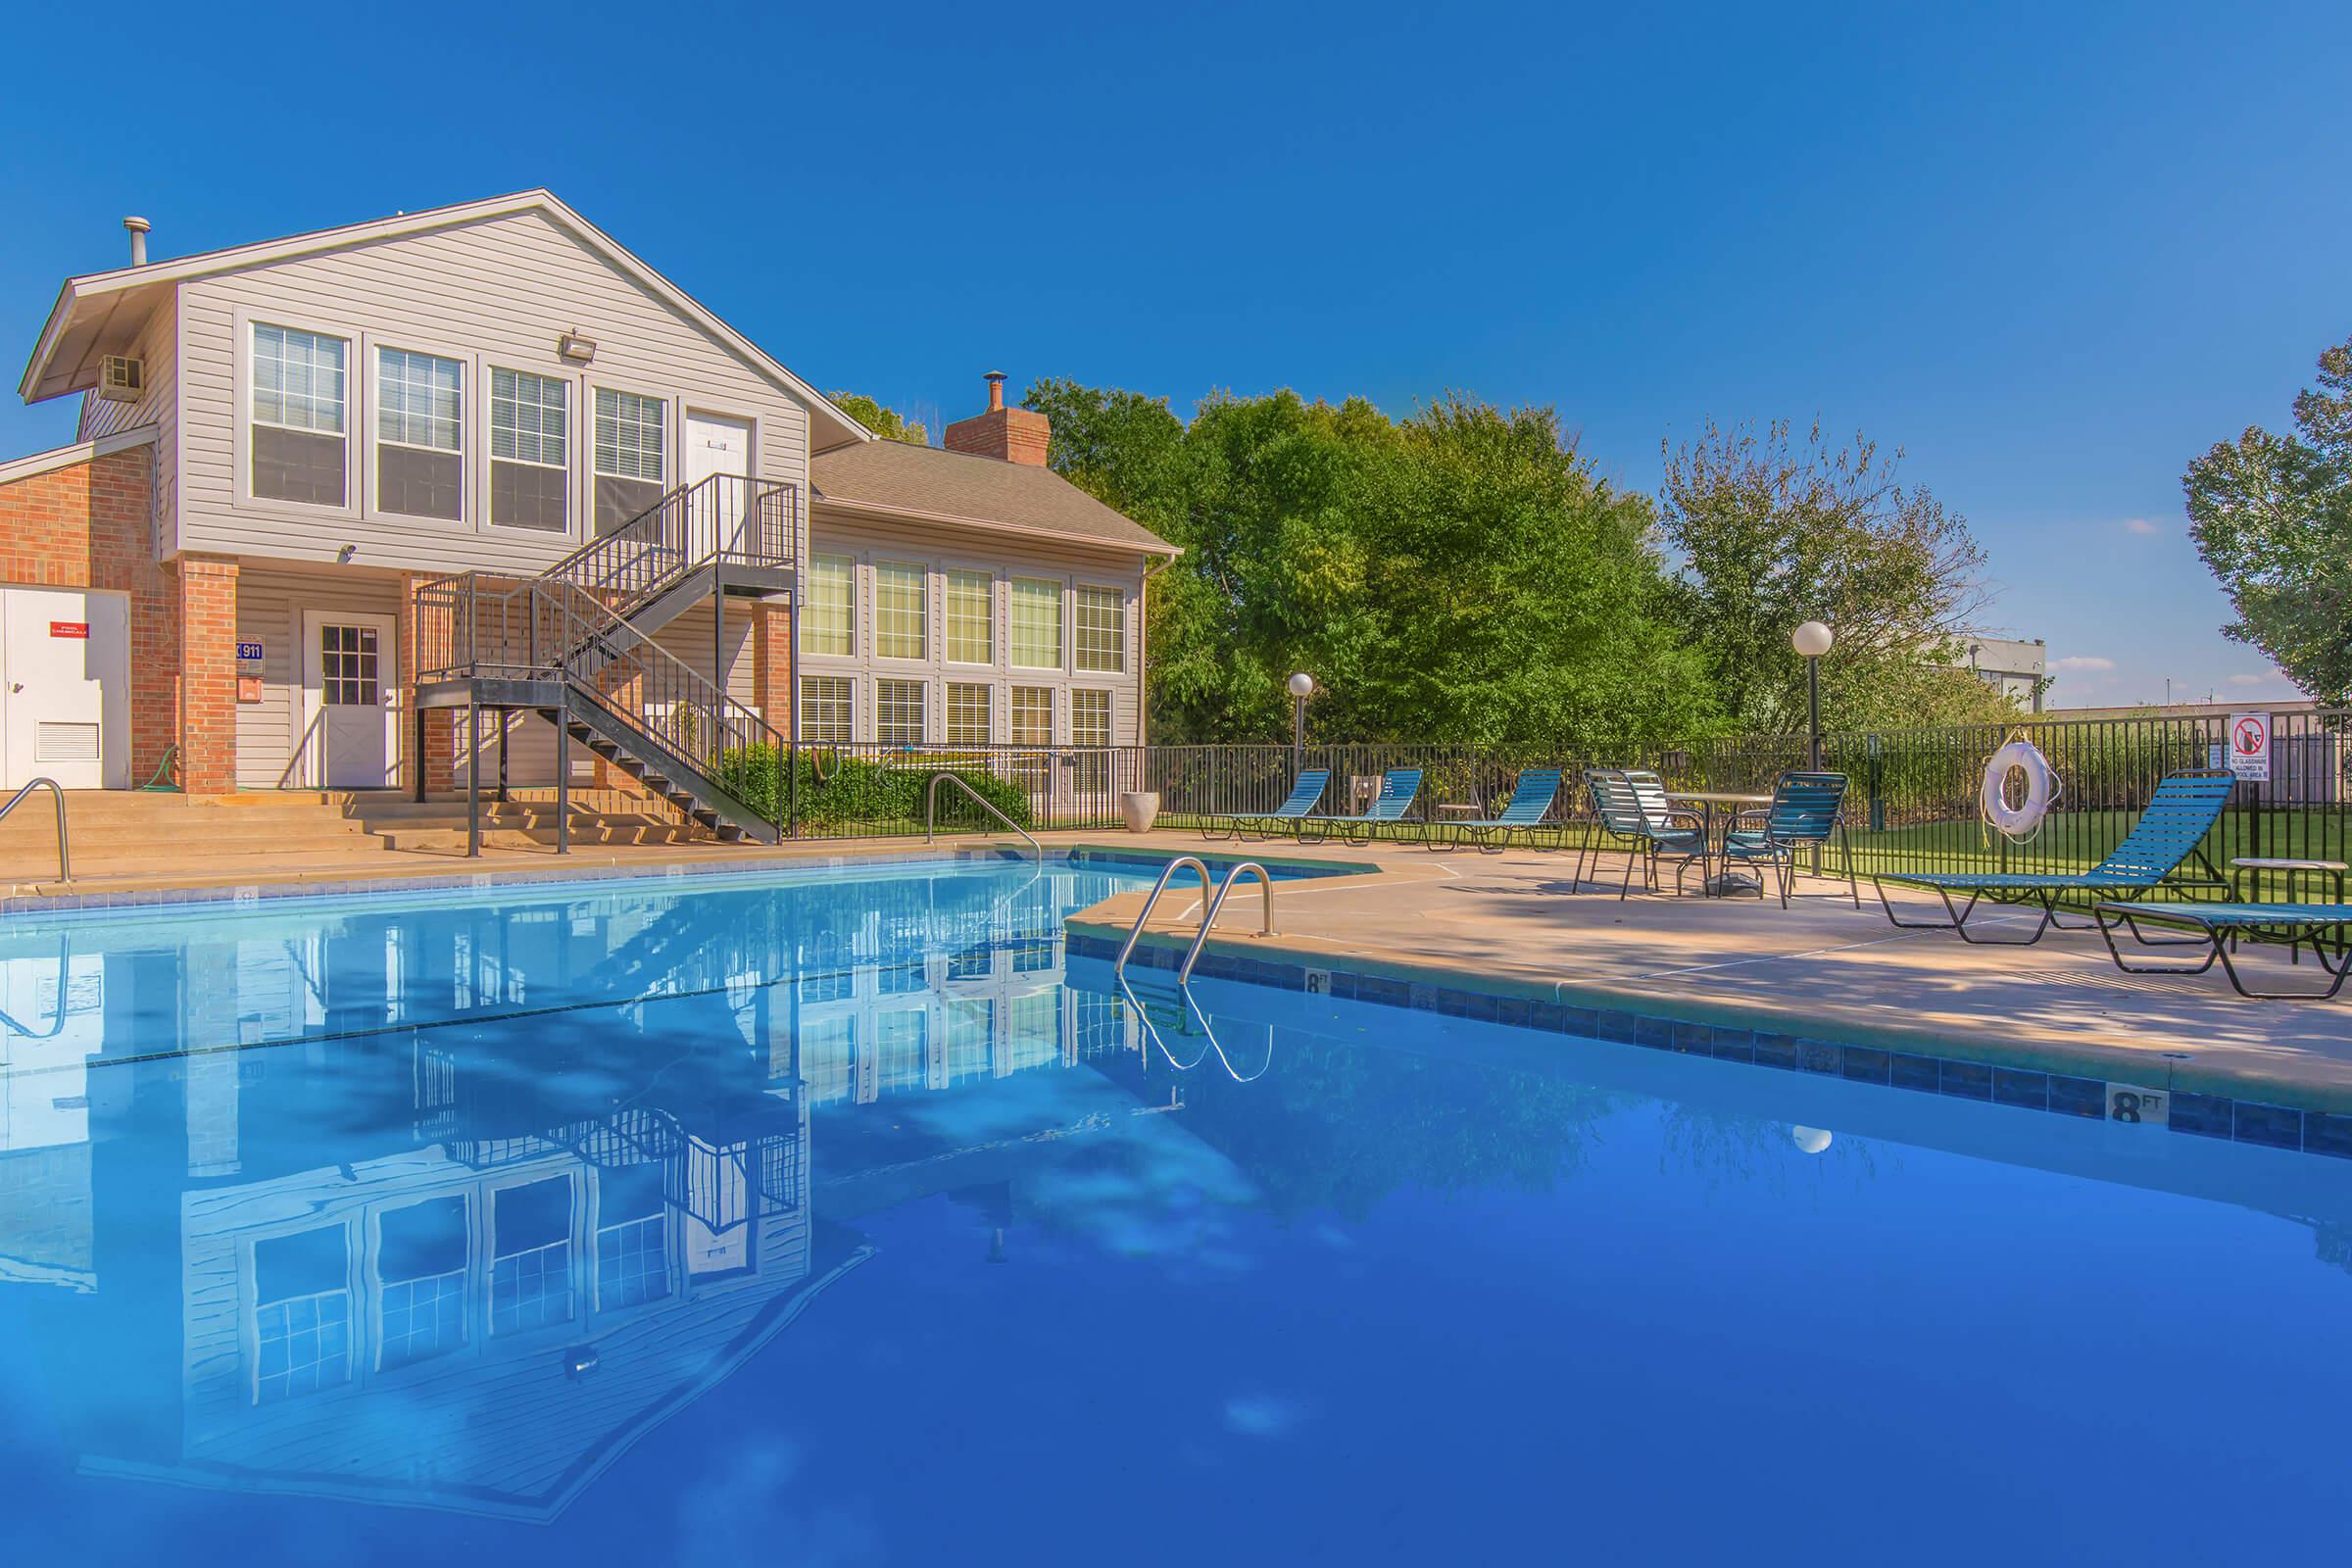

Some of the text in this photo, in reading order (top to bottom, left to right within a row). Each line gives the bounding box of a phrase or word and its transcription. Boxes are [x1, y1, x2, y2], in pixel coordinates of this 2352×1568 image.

[243, 645, 260, 658] 911
[1307, 973, 1319, 994] 8
[2113, 1092, 2163, 1123] 8 FT
